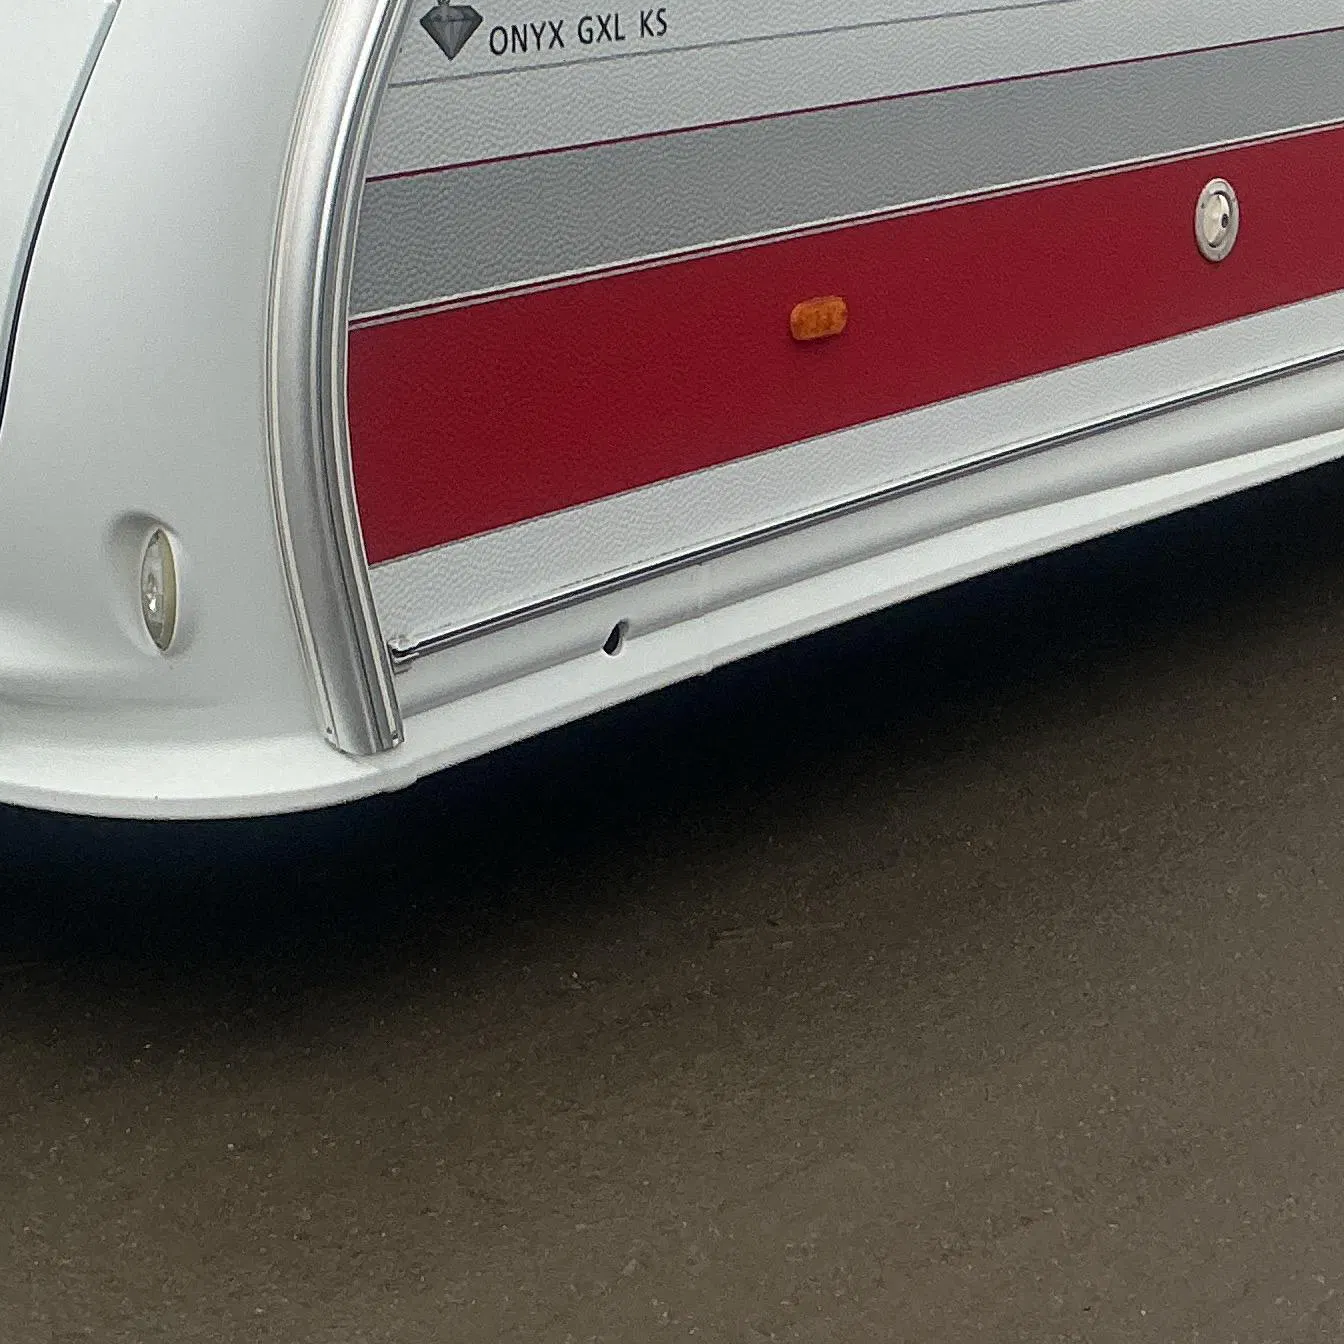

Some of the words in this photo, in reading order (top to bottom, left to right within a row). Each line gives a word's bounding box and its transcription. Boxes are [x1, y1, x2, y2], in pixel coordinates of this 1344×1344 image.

[489, 19, 565, 56] ONYX
[577, 12, 626, 45] GXL
[639, 7, 668, 38] KS
